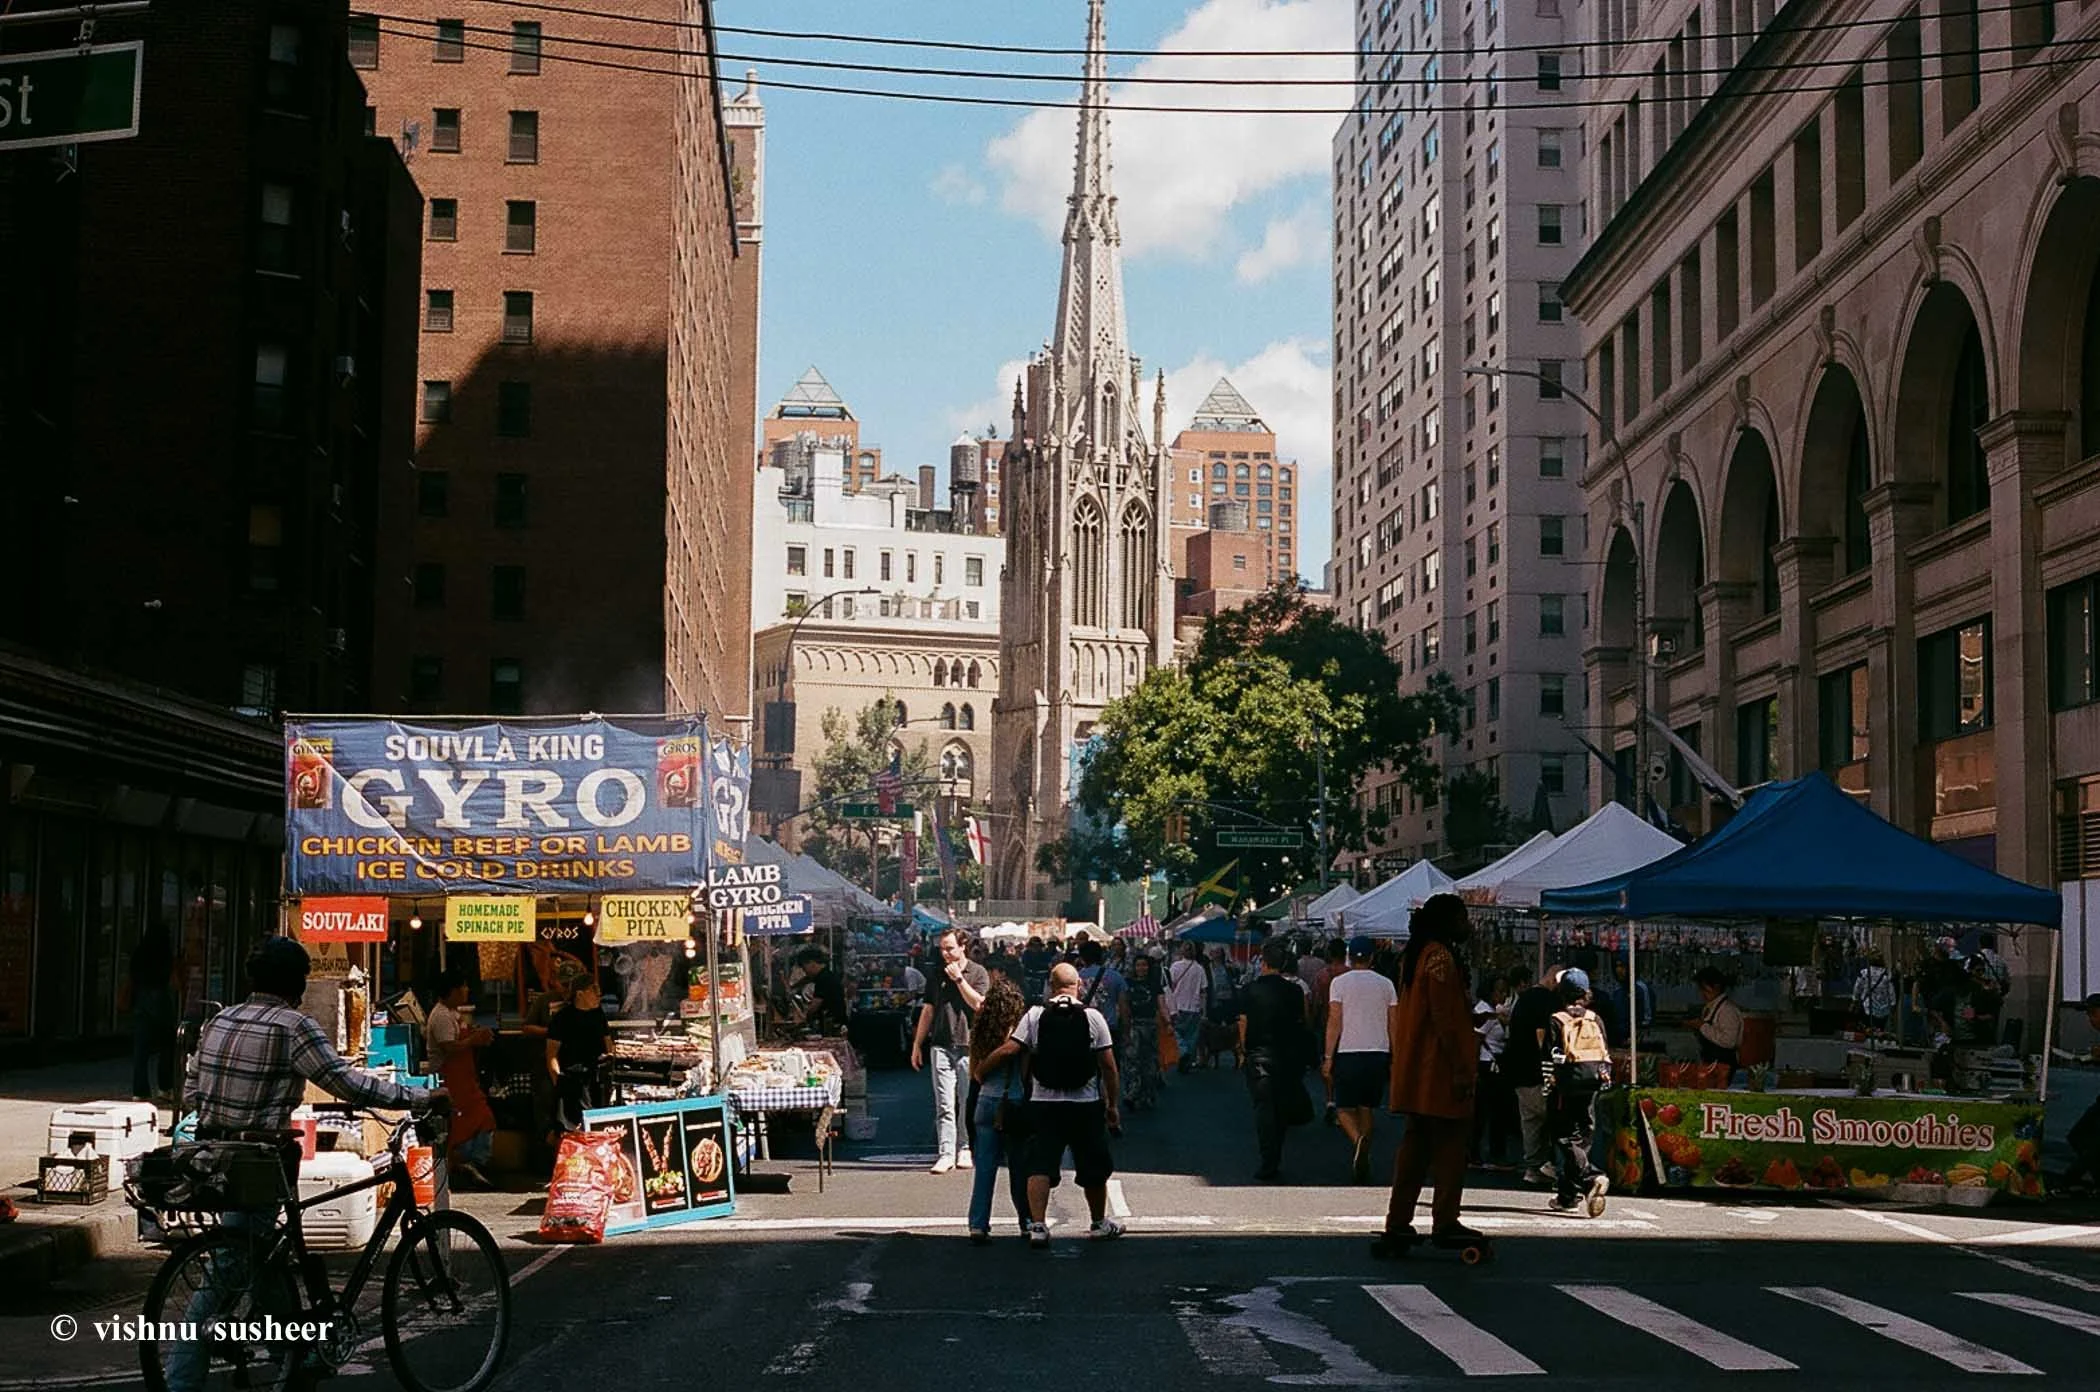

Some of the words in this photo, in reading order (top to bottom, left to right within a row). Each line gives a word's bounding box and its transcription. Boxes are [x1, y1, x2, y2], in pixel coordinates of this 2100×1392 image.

[385, 735, 517, 762] SOUVLA
[528, 734, 605, 761] KING
[342, 768, 646, 829] GYRO
[302, 836, 443, 857] CHICKEN
[453, 836, 533, 856] BEEF
[540, 836, 588, 855] OR
[597, 834, 693, 854] LAMB
[357, 860, 407, 880] ICE
[415, 860, 506, 880] COLD
[516, 859, 637, 879] DRINKS
[709, 864, 781, 888] LAMB
[710, 884, 782, 909] GYRO
[459, 904, 520, 917] HOMEMADE
[606, 900, 687, 919] CHICKEN
[744, 900, 804, 916] CHICKEN
[302, 912, 385, 932] SOUVLAKI
[456, 920, 504, 933] SPINACH
[507, 920, 525, 933] PIE
[626, 919, 667, 937] PITA
[758, 916, 791, 930] PITA
[1700, 1103, 1806, 1143] Fresh
[1813, 1108, 1995, 1151] Smoothies
